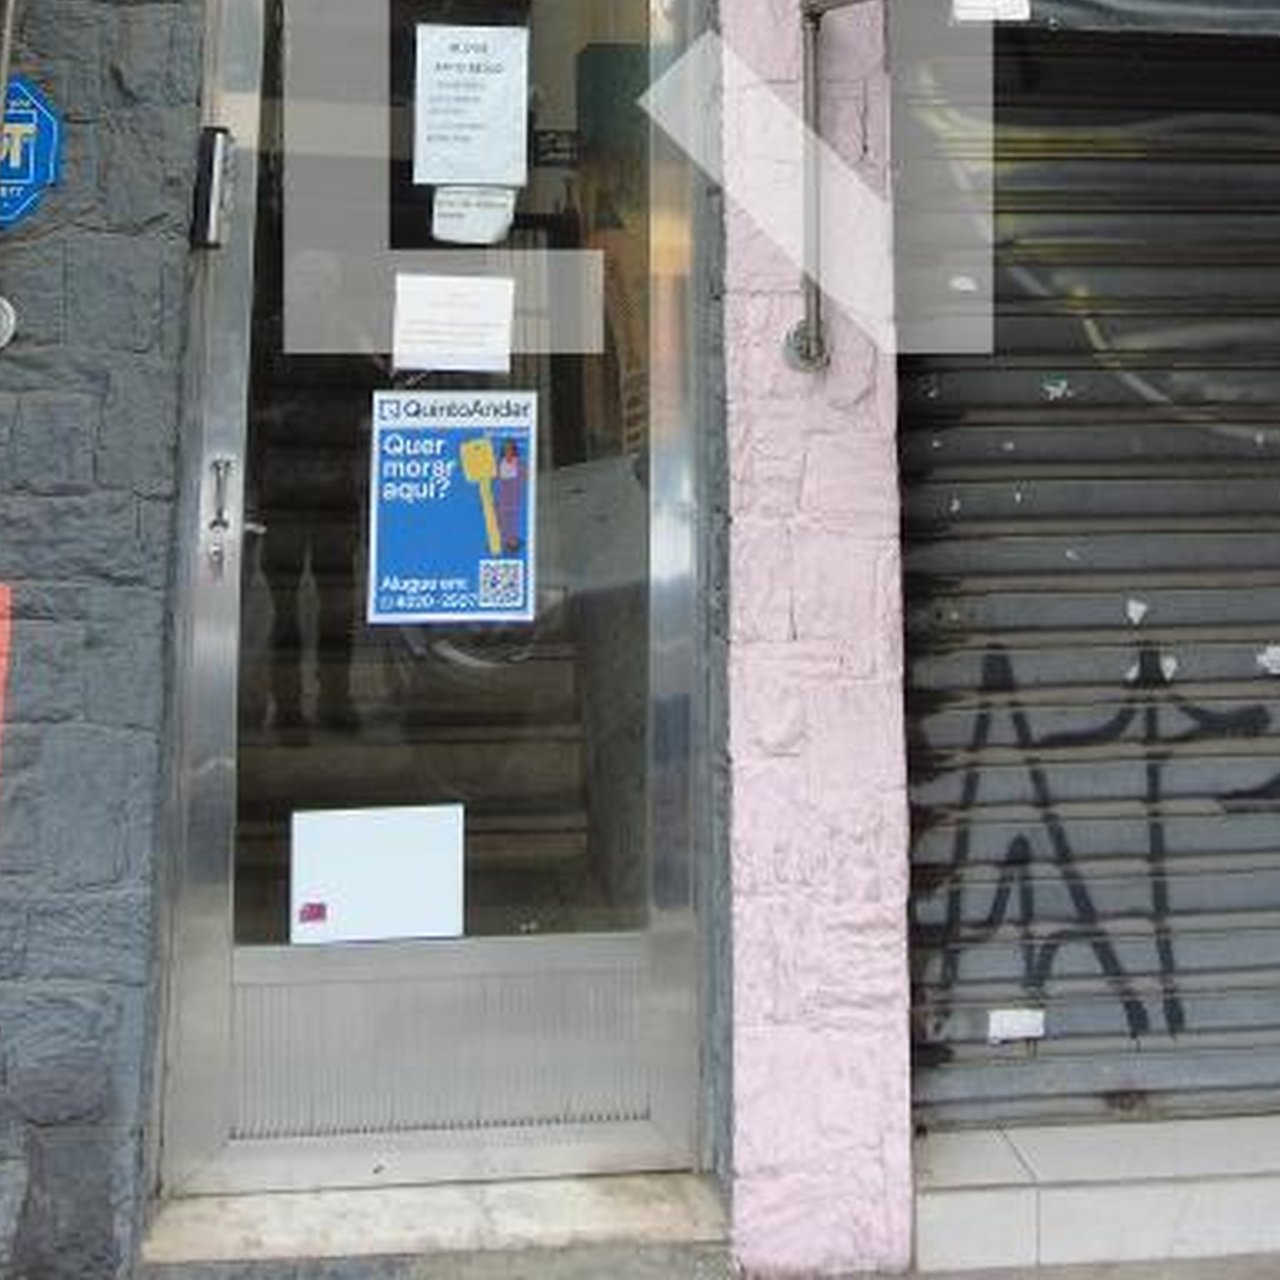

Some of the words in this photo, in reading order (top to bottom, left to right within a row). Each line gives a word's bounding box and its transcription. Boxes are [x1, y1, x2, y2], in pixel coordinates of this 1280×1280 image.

[404, 399, 531, 418] QuintoAndar
[382, 433, 445, 455] Quer
[382, 458, 455, 478] morar
[382, 478, 452, 502] aqui?
